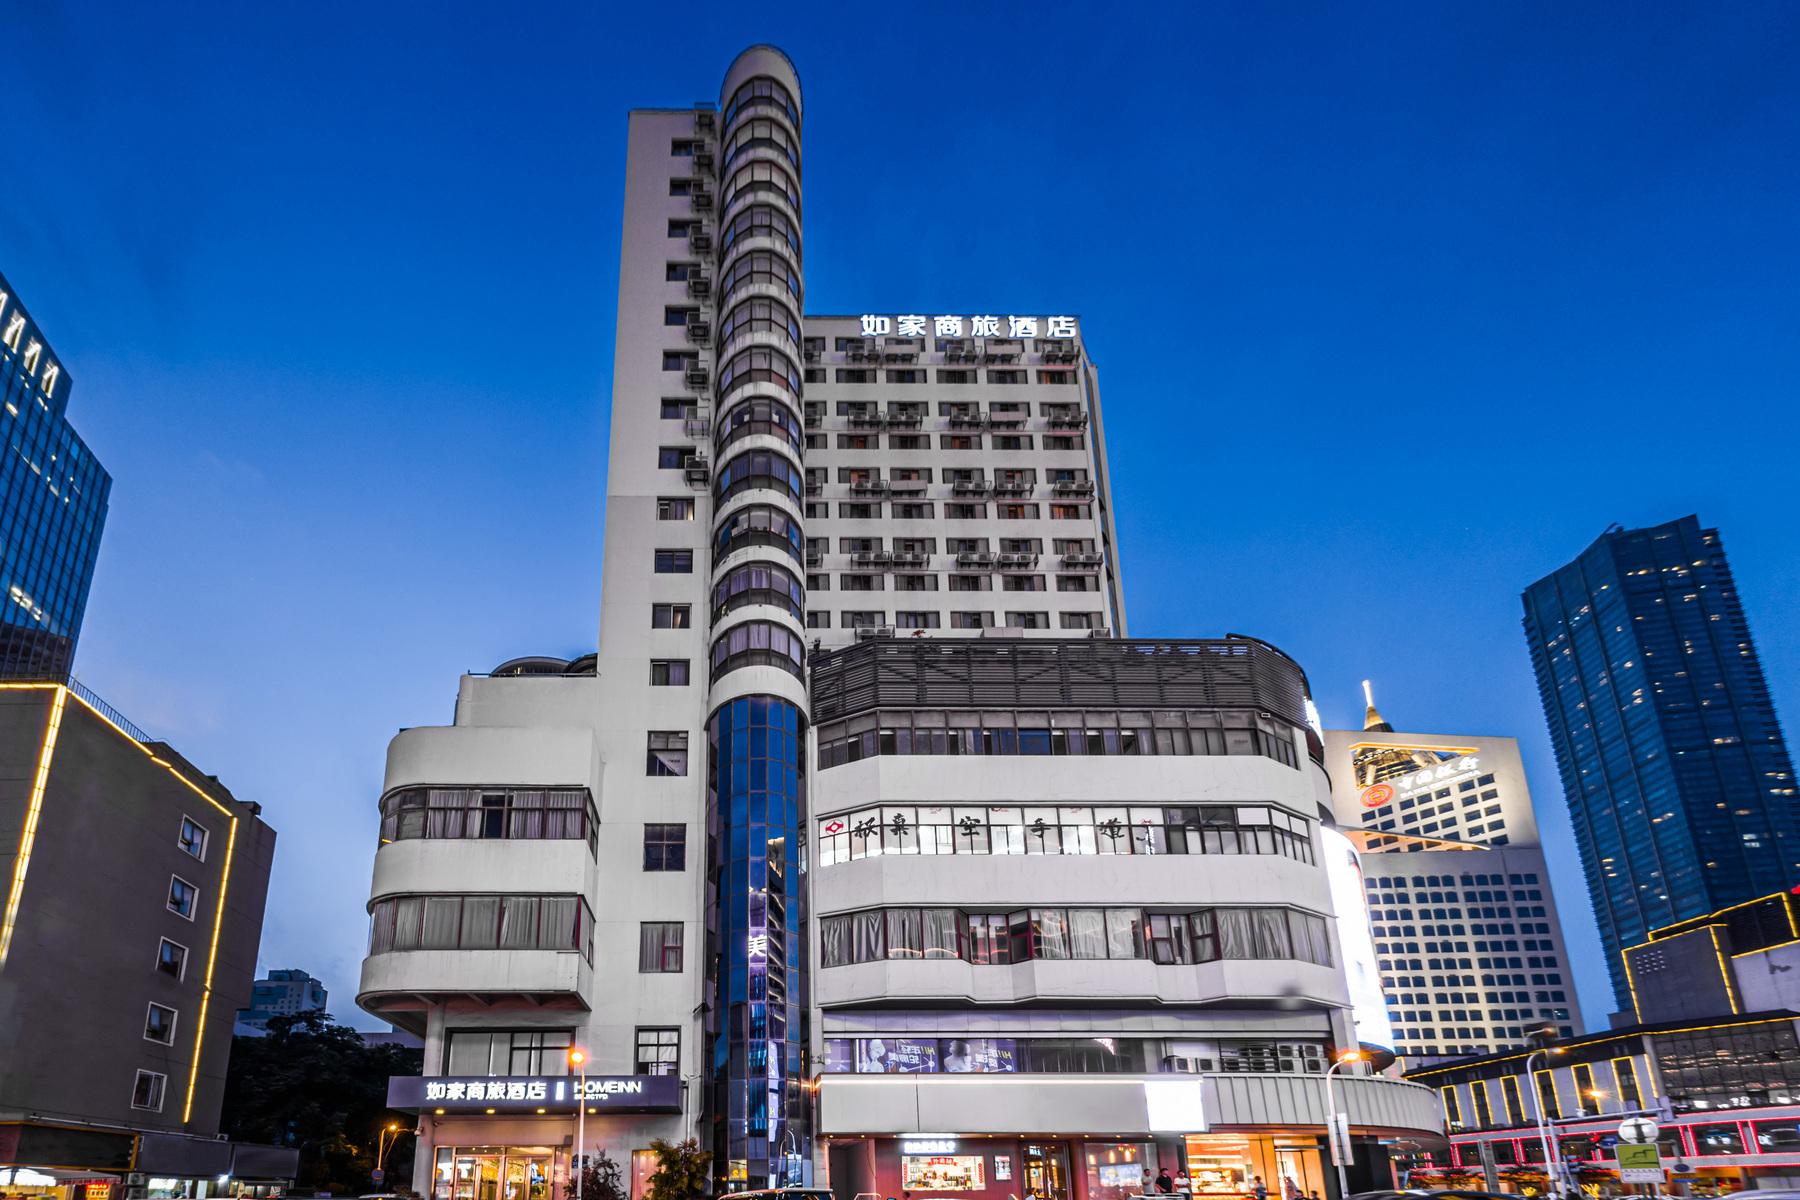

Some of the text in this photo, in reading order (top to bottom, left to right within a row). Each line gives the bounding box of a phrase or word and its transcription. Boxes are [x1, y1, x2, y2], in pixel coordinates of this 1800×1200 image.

[861, 314, 1077, 338] 如家商旅酒店
[426, 1082, 547, 1100] 如家商旅酒店
